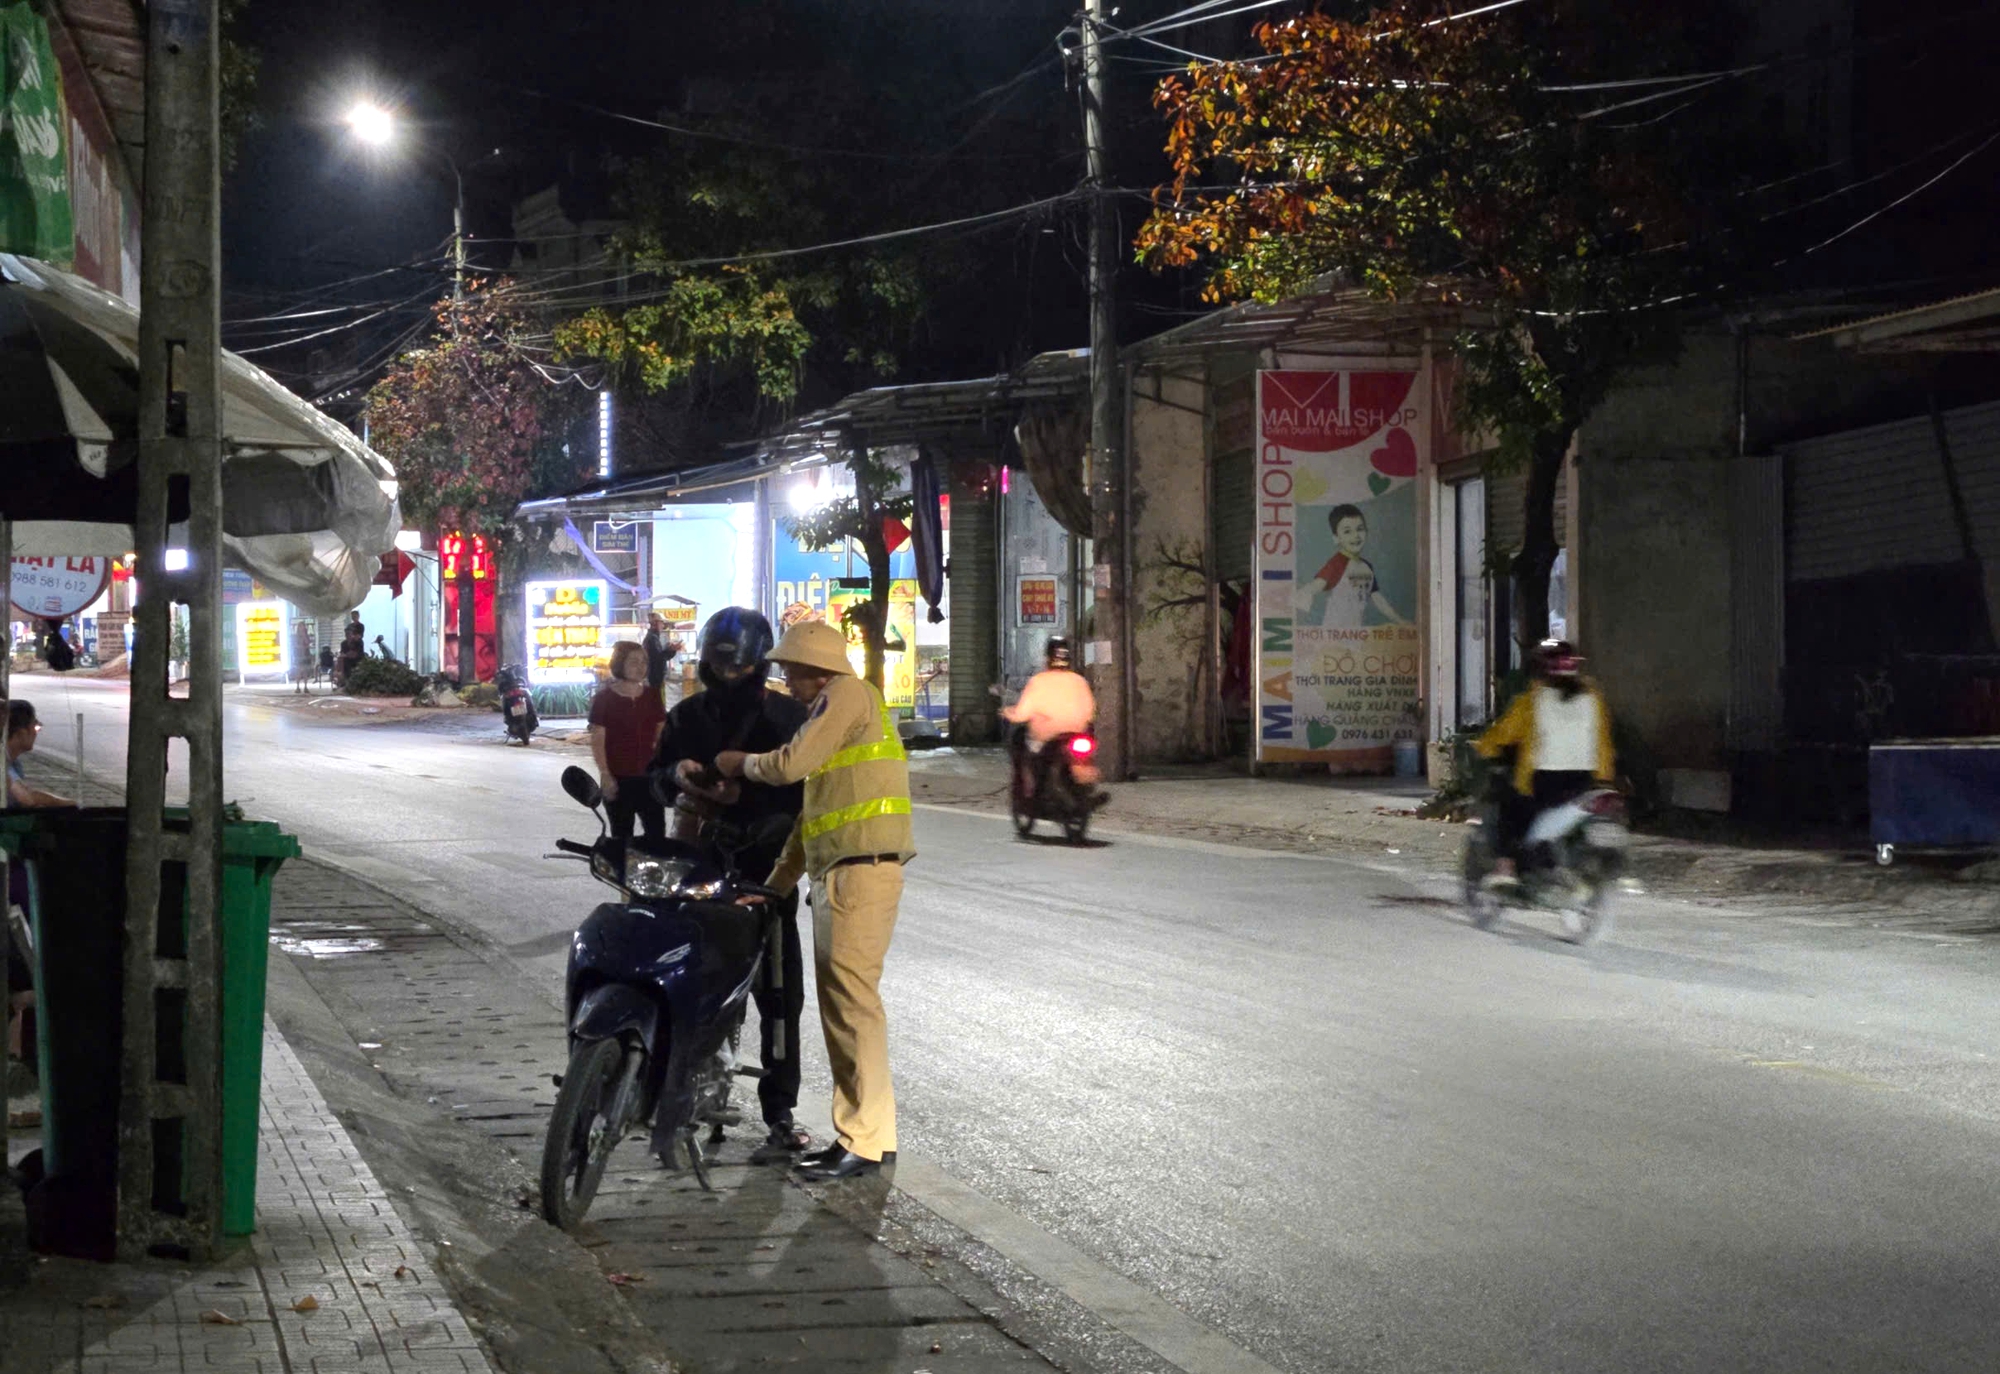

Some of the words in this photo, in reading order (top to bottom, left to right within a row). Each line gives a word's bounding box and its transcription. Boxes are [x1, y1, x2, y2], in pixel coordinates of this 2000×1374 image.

[1262, 408, 1298, 427] MAI
[1306, 408, 1347, 427] MAI
[1354, 408, 1418, 427] SHOP
[1262, 440, 1293, 555] SHOP
[40, 576, 60, 588] 581
[64, 581, 87, 593] 612
[1327, 629, 1369, 641] TRANG
[1324, 676, 1361, 686] TRANG
[1365, 676, 1386, 686] GIA
[1342, 729, 1368, 740] 0976
